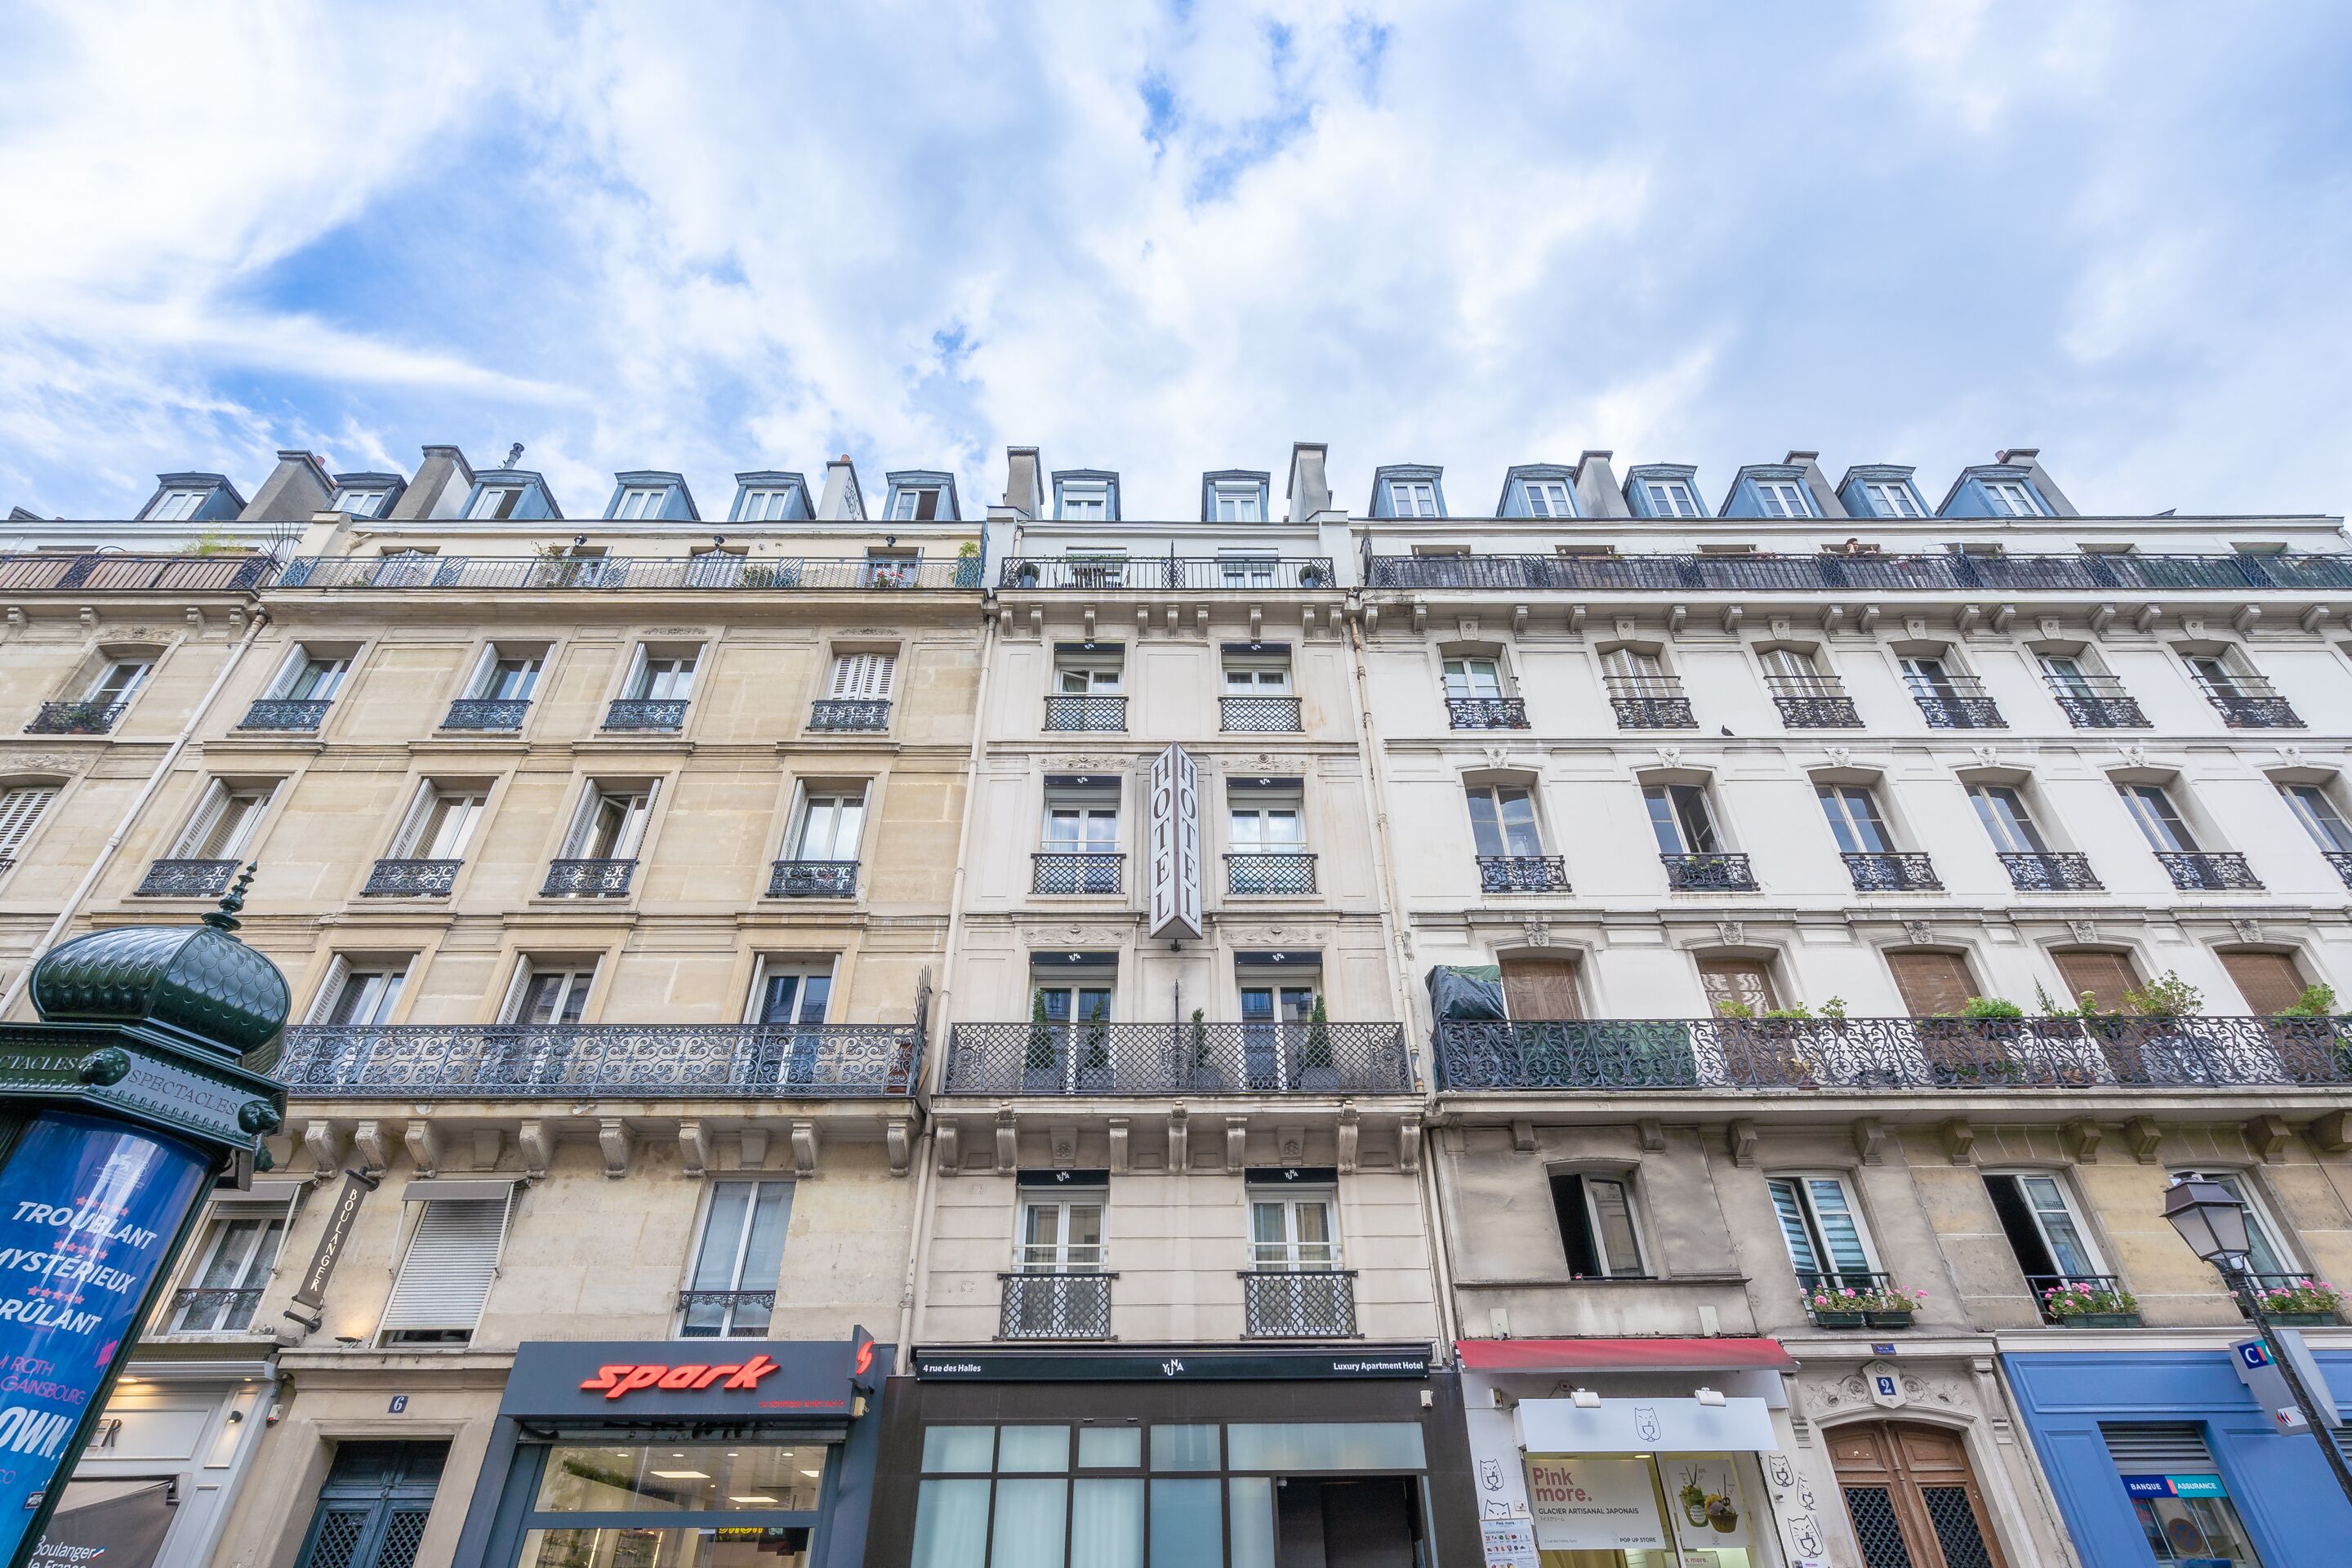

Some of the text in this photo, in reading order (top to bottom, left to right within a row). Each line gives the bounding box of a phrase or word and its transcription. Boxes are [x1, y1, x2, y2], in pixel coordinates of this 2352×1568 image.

[1153, 754, 1171, 924] HOTEL
[1179, 754, 1197, 924] HOTEL
[1068, 952, 1081, 962] YUNA
[1272, 952, 1285, 961] YUNA
[128, 1070, 238, 1116] SPECTACLES
[1056, 1171, 1071, 1182] YUNA
[1285, 1169, 1298, 1180] YUNA
[11, 1201, 158, 1250] TROUBLANT
[310, 1188, 358, 1292] BOULANGER
[0, 1297, 103, 1335] RÛLANT
[2244, 1346, 2274, 1363] CI
[10, 1356, 55, 1376] ROTH
[957, 1364, 982, 1373] Halles
[1162, 1358, 1184, 1376] YUNA
[1334, 1361, 1423, 1371] Luxury Apartment Hotel
[1, 1375, 86, 1405] GAINSBOURG
[1880, 1379, 1892, 1393] 2
[394, 1396, 405, 1411] 6
[1532, 1467, 1574, 1486] Pink
[1535, 1487, 1592, 1502] more.
[33, 1535, 96, 1561] Boulanger
